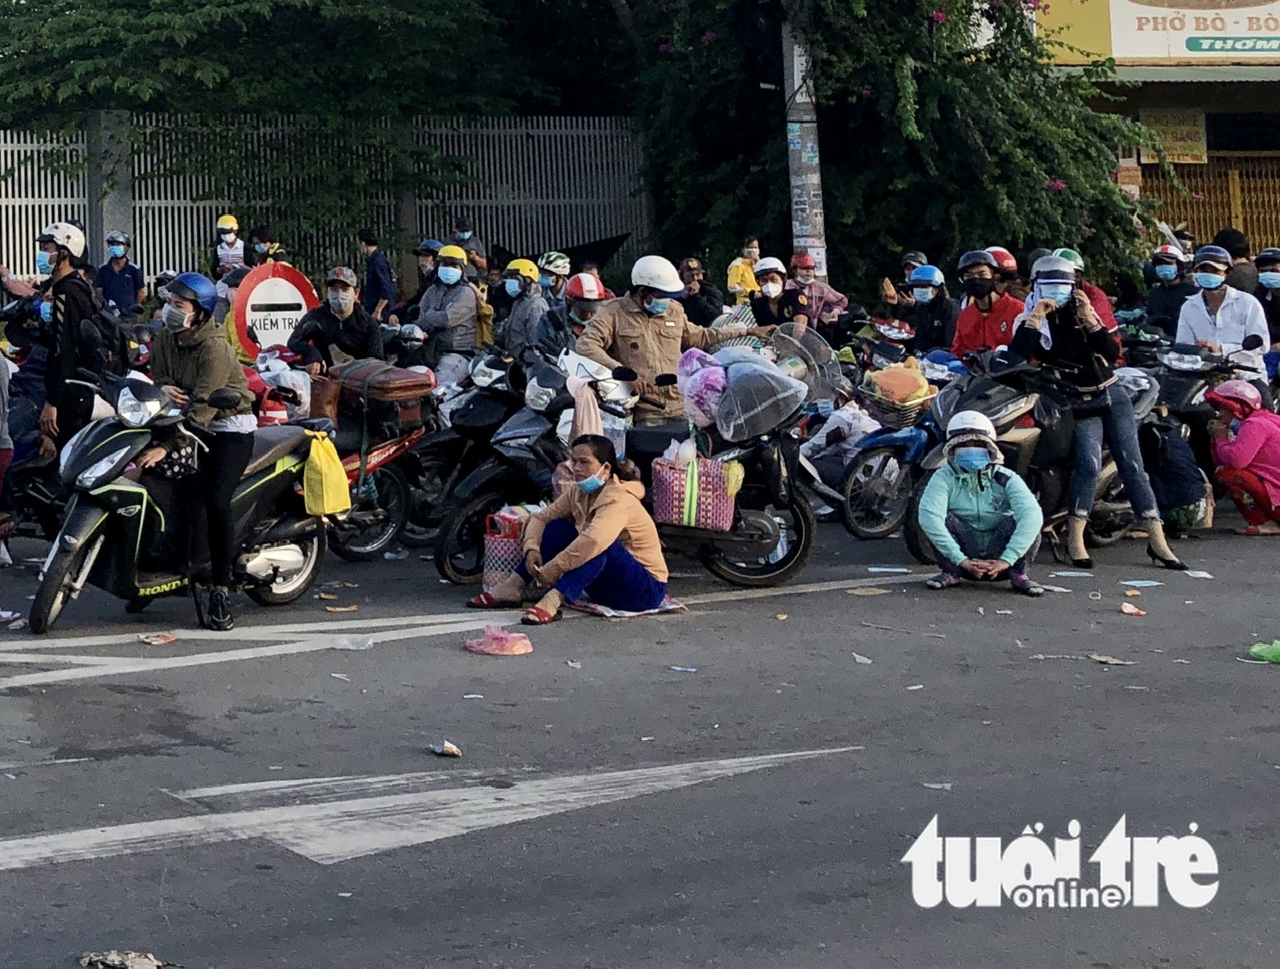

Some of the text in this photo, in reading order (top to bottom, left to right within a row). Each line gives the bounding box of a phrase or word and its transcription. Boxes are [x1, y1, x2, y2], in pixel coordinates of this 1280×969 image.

[1136, 10, 1186, 31] PHỞ
[251, 313, 279, 330] KIỂM
[138, 578, 189, 596] HONDA
